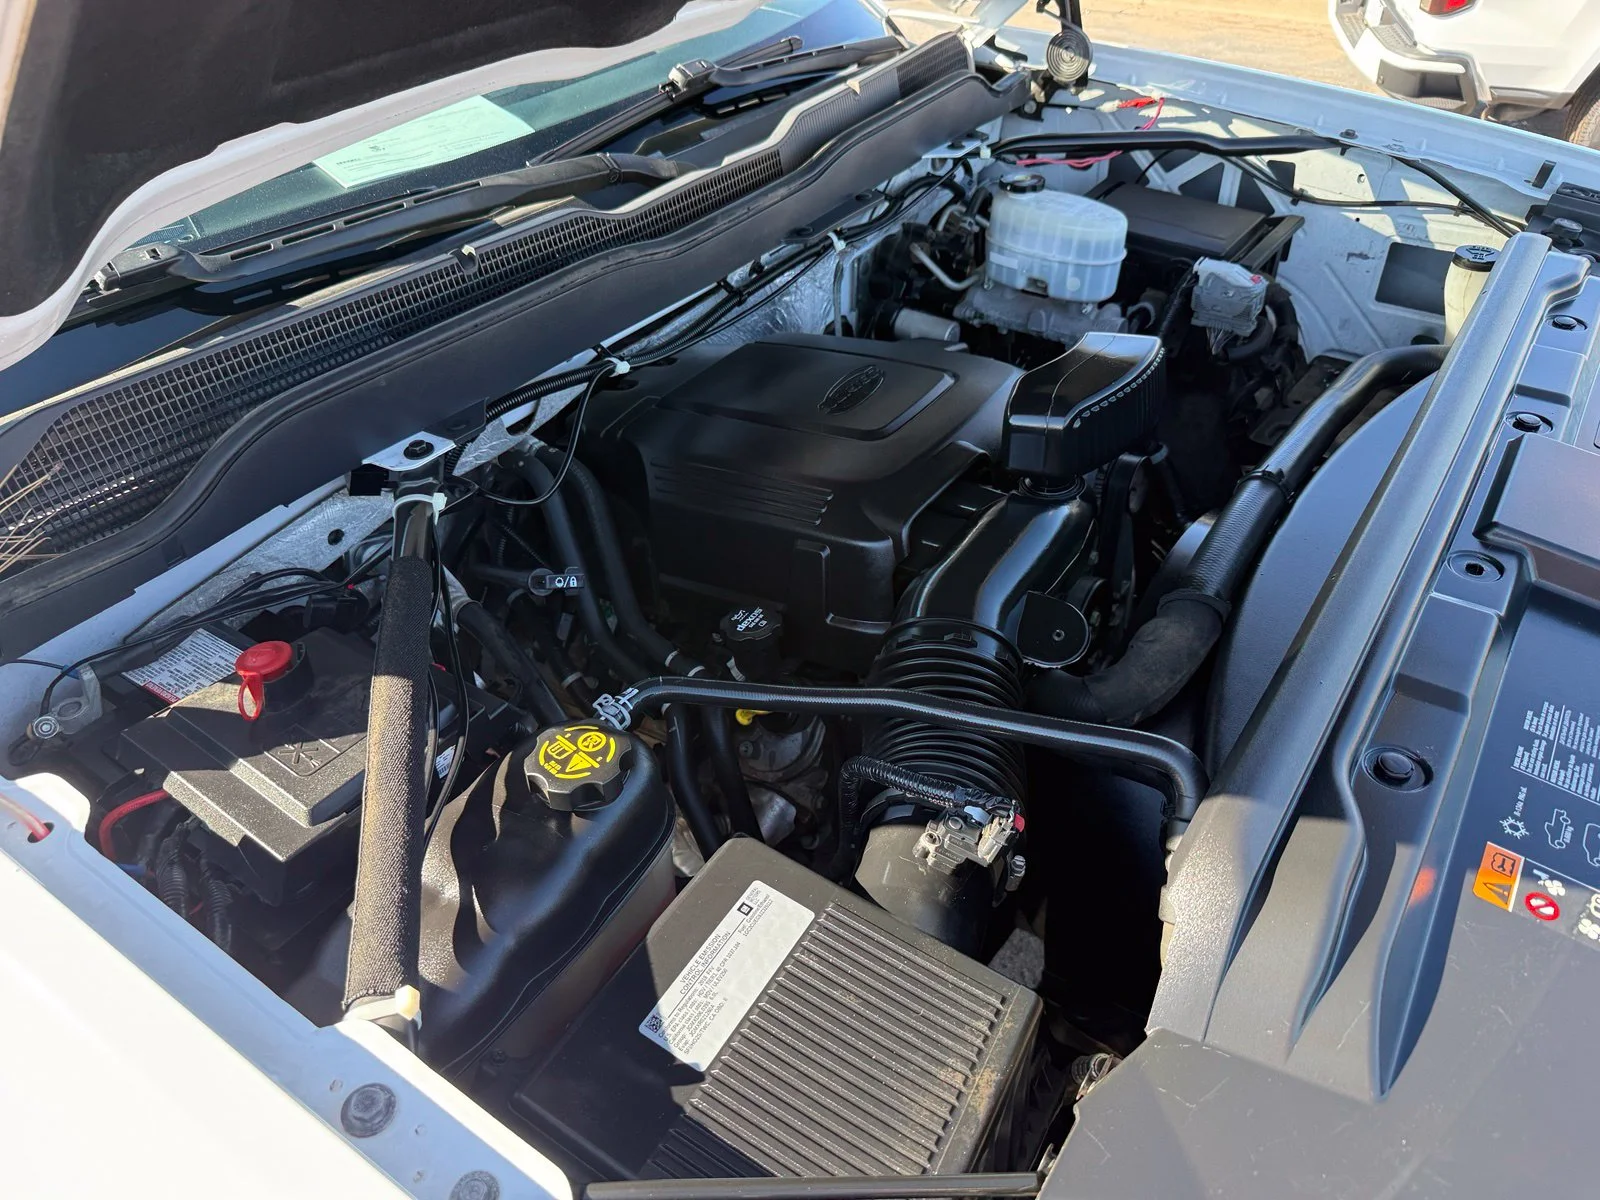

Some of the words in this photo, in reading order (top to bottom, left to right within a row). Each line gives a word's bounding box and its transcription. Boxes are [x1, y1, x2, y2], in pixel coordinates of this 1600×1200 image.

[736, 606, 763, 632] dexos
[679, 967, 702, 995] CONTROL
[700, 931, 730, 968] INFORMATION
[680, 959, 700, 984] VEHICLE
[699, 934, 720, 960] EMISSION
[658, 1016, 675, 1038] Conforms
[669, 1024, 685, 1044] California
[684, 1013, 693, 1024] class
[678, 1011, 687, 1023] class
